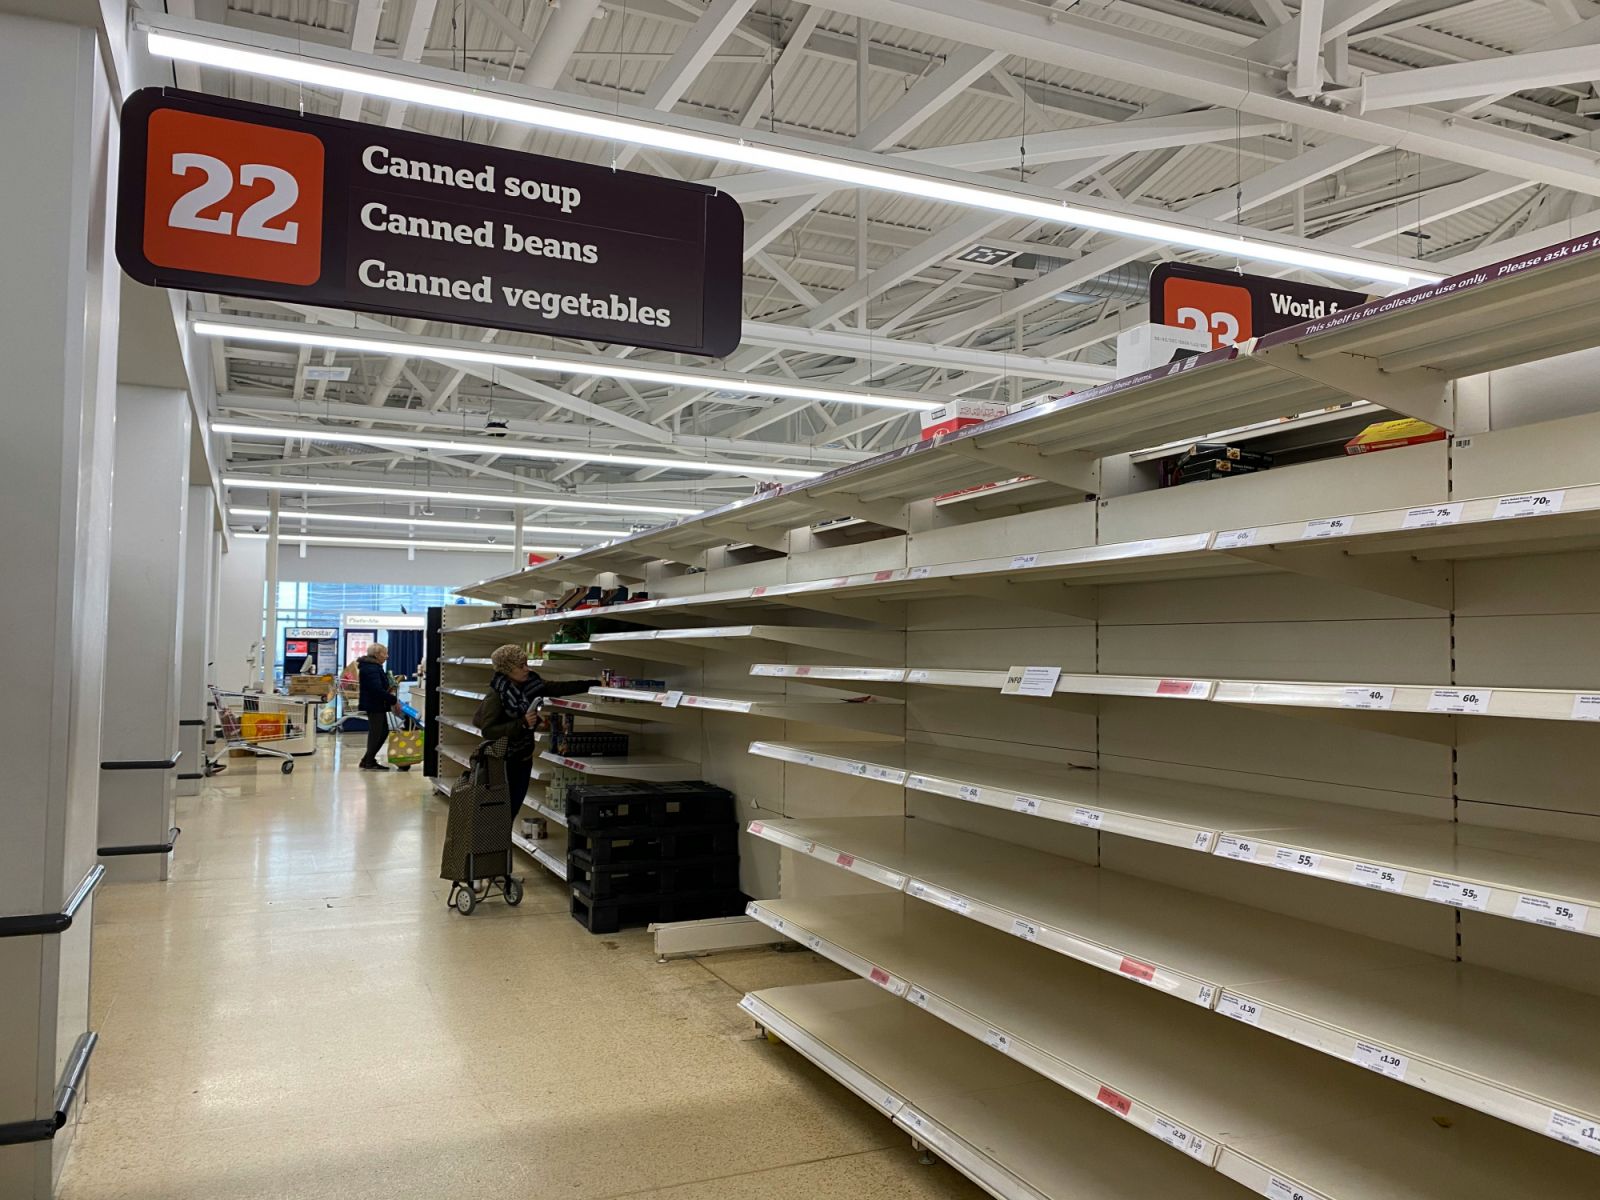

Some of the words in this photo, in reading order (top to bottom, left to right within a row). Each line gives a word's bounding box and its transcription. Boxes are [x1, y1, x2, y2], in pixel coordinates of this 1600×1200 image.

[361, 145, 496, 193] Canned
[504, 173, 582, 214] soup
[167, 152, 300, 245] 22
[360, 201, 495, 249] Canned
[503, 224, 599, 265] beans
[1305, 322, 1325, 335] This
[1325, 312, 1351, 329] shelf
[1352, 311, 1362, 321] is
[1363, 307, 1378, 318] for
[1379, 290, 1433, 312] colleague
[1435, 283, 1457, 295] use
[1458, 273, 1488, 289] only.
[1498, 256, 1542, 276] Please
[1543, 246, 1570, 262] ask
[1571, 241, 1589, 253] us
[1592, 236, 1600, 248] t
[357, 258, 493, 305] Canned
[502, 285, 671, 328] vegetables
[1270, 292, 1326, 320] World
[1329, 302, 1345, 316] f
[1533, 497, 1551, 507] 70p
[1436, 508, 1451, 517] 75p
[1330, 520, 1343, 528] 85p
[301, 629, 332, 637] coinstar
[1007, 676, 1022, 684] INFO
[1369, 690, 1384, 701] 40p
[1462, 693, 1479, 704] 60p
[1239, 843, 1251, 853] 60p
[1297, 855, 1314, 868] 55p
[1381, 871, 1395, 883] 55p
[1461, 888, 1478, 900] 55p
[1554, 906, 1574, 920] 55p
[1240, 1003, 1256, 1015] £1.30
[1380, 1054, 1401, 1067] £1.30
[1172, 1129, 1186, 1141] £2.20
[1582, 1126, 1600, 1143] £1.
